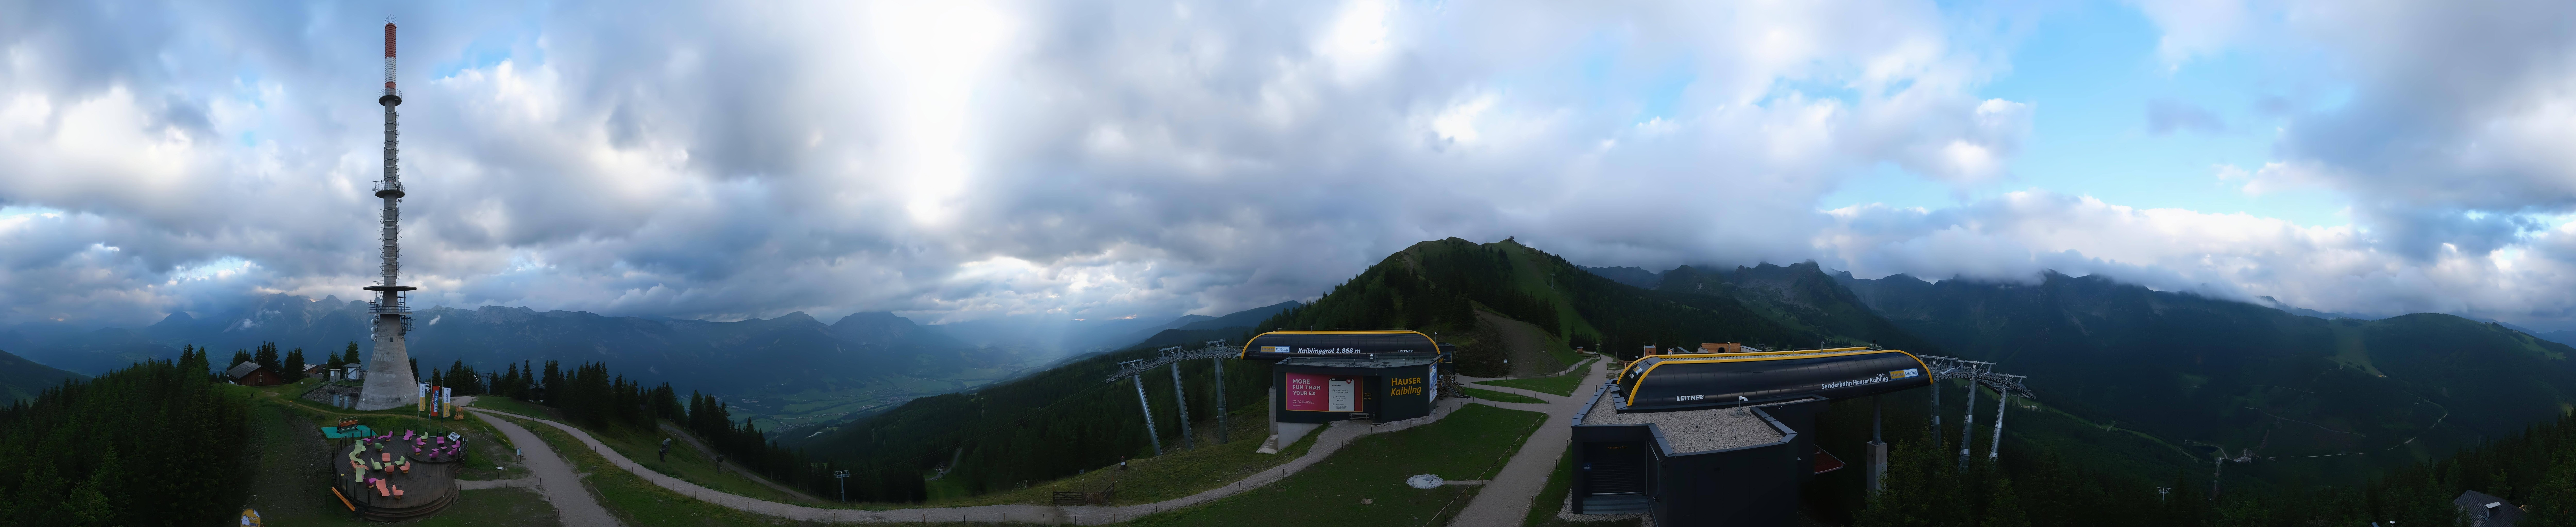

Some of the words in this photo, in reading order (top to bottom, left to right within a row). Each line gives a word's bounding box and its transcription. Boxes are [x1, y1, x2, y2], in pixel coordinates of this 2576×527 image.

[1391, 377, 1421, 386] HAUSER
[1822, 380, 1852, 389] Senderbahn
[1391, 386, 1421, 396] Kaibling
